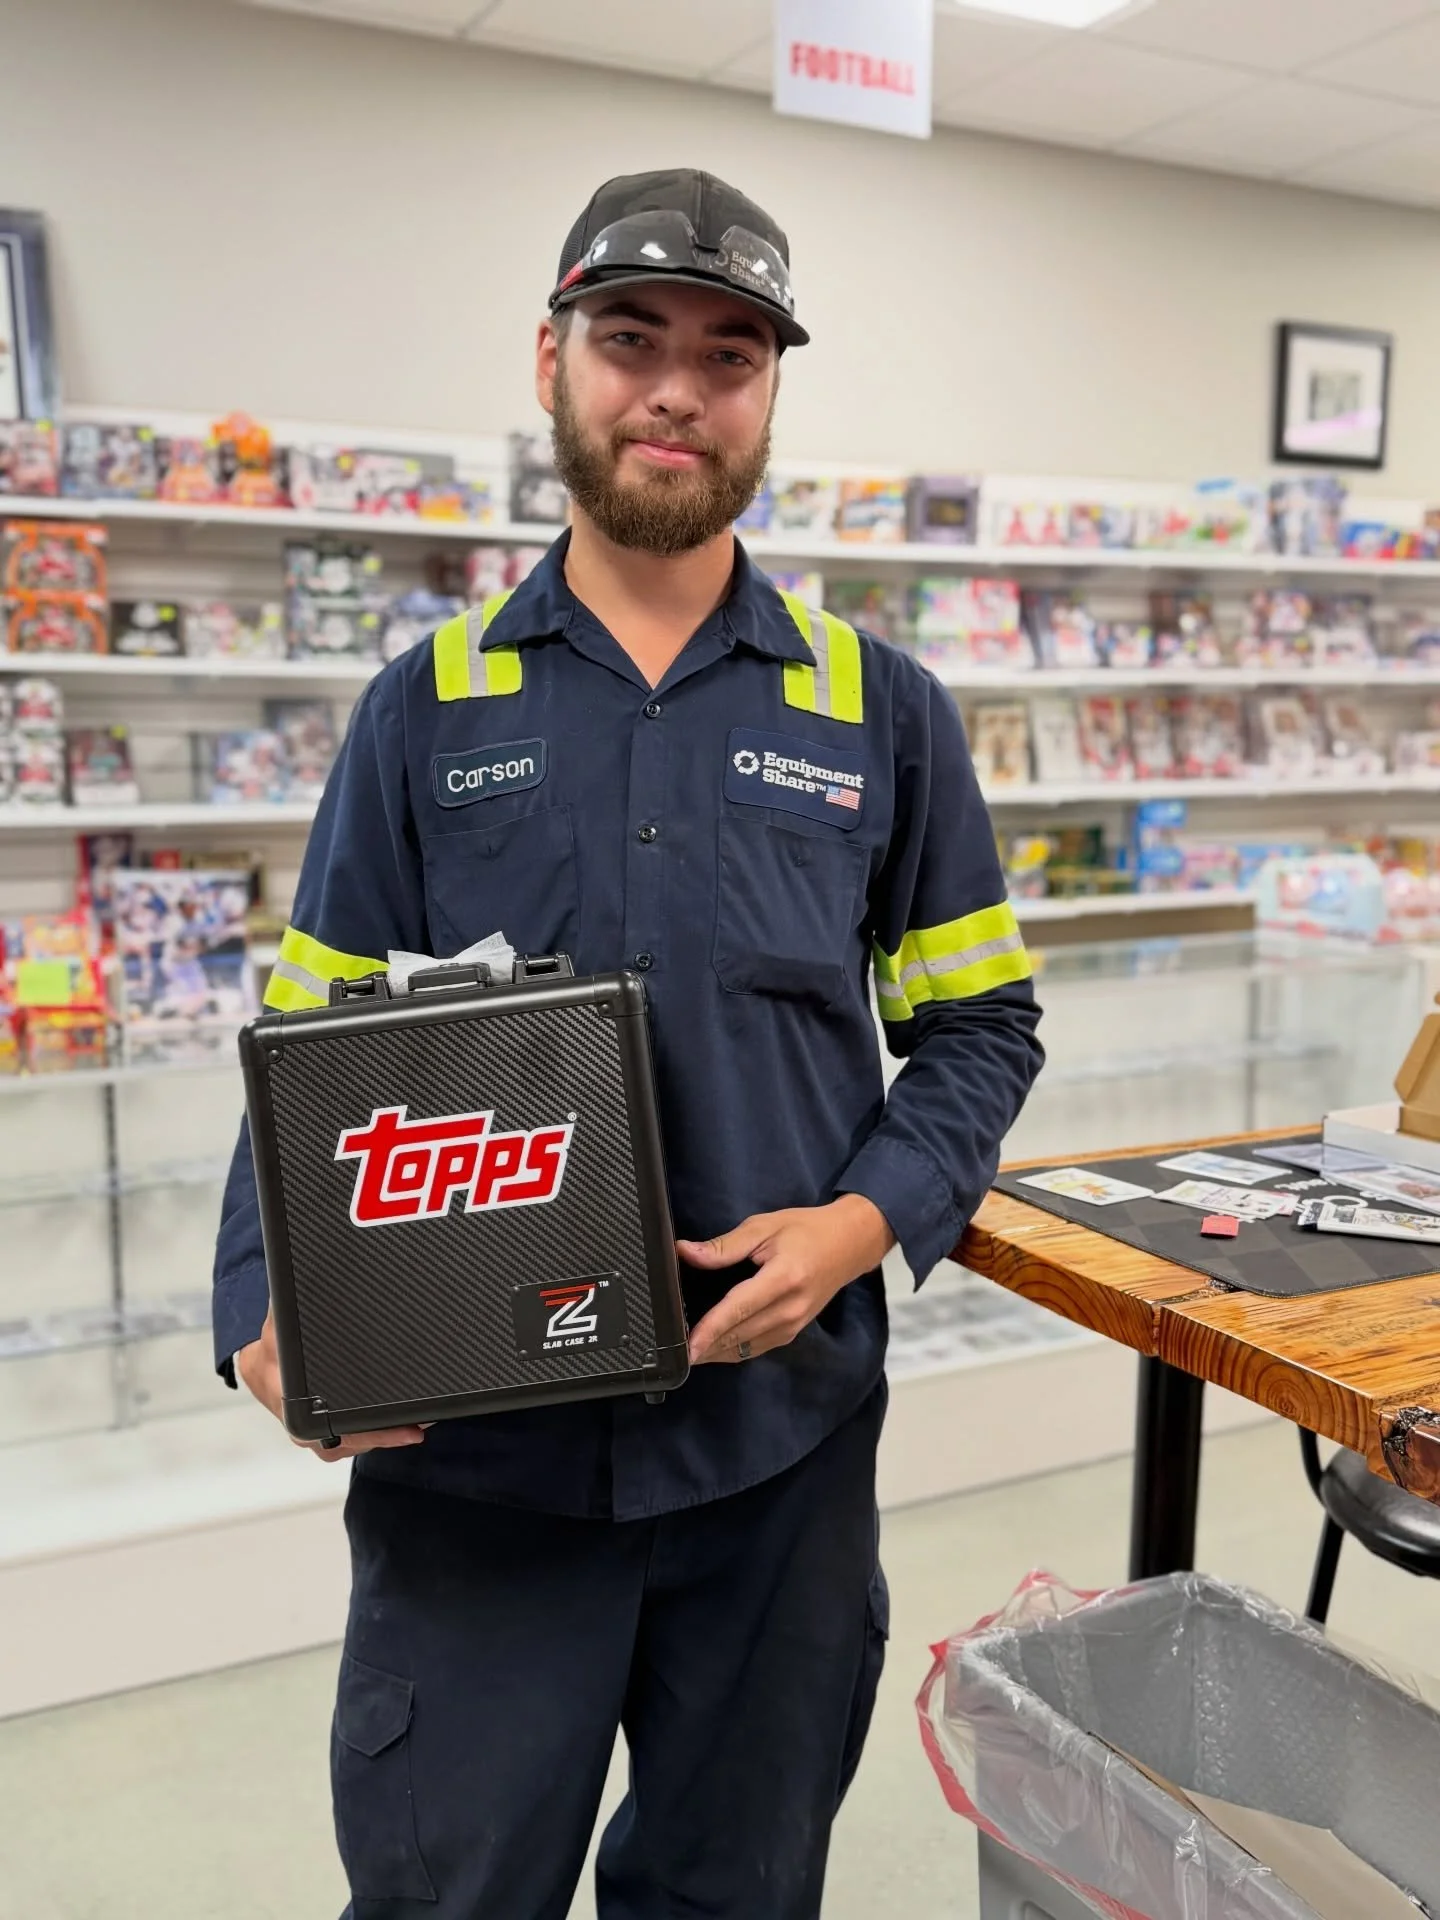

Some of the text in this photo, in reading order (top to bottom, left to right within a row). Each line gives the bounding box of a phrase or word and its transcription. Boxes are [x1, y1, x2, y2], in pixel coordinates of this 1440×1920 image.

[790, 42, 915, 96] FOOTBALL
[446, 757, 534, 793] Carson
[762, 751, 865, 789] Equipment
[542, 1340, 562, 1350] SLAB
[565, 1336, 585, 1346] CASE
